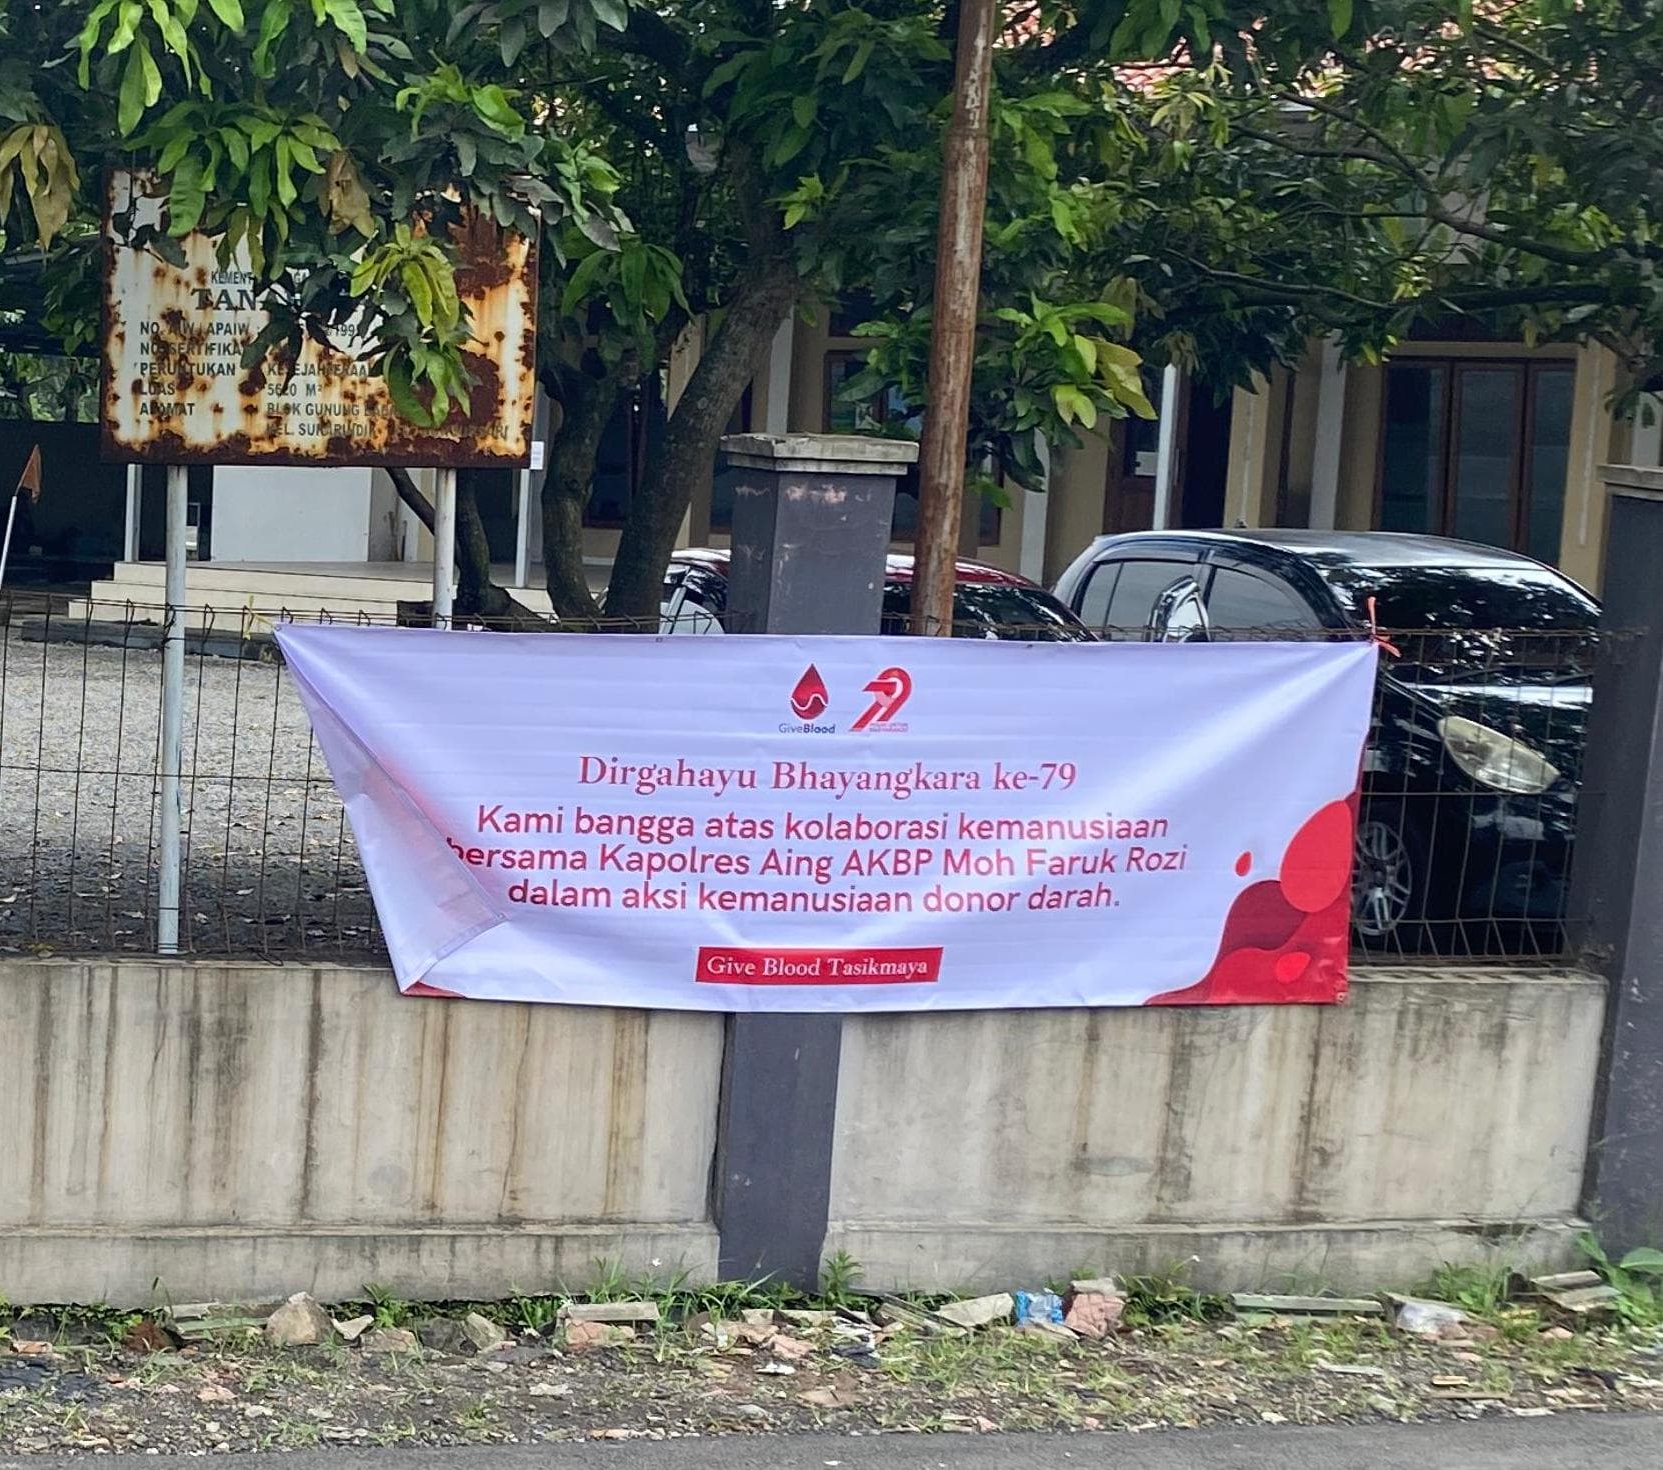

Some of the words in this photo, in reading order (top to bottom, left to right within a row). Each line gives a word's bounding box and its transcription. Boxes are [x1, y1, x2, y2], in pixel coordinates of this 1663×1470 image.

[140, 362, 236, 376] PERUTUKAN
[305, 402, 360, 417] GUNUNG
[778, 723, 836, 734] GiveBlood
[577, 755, 757, 797] Dirgahayu
[771, 761, 981, 799] Bhayangkara
[993, 762, 1077, 790] ke-79
[478, 804, 563, 834] Kami
[575, 806, 694, 844] bangga
[705, 813, 774, 839] atas
[785, 812, 948, 840] kolaborasi
[959, 812, 1168, 840] kemanusiaan
[599, 844, 749, 880] Kapolres
[760, 848, 833, 883] Aing
[841, 849, 933, 876] AKBP
[943, 848, 1015, 876] Moh
[1026, 848, 1117, 876] Faruk
[1126, 844, 1187, 871] Rozi
[508, 878, 614, 908] dalam
[622, 881, 687, 909] aksi
[699, 881, 912, 912] kemanusiaan
[922, 884, 1022, 912] donor
[1028, 882, 1120, 911] darah.
[706, 955, 756, 977] Give
[762, 957, 821, 977] Blood
[828, 957, 928, 979] Tasikmaya
